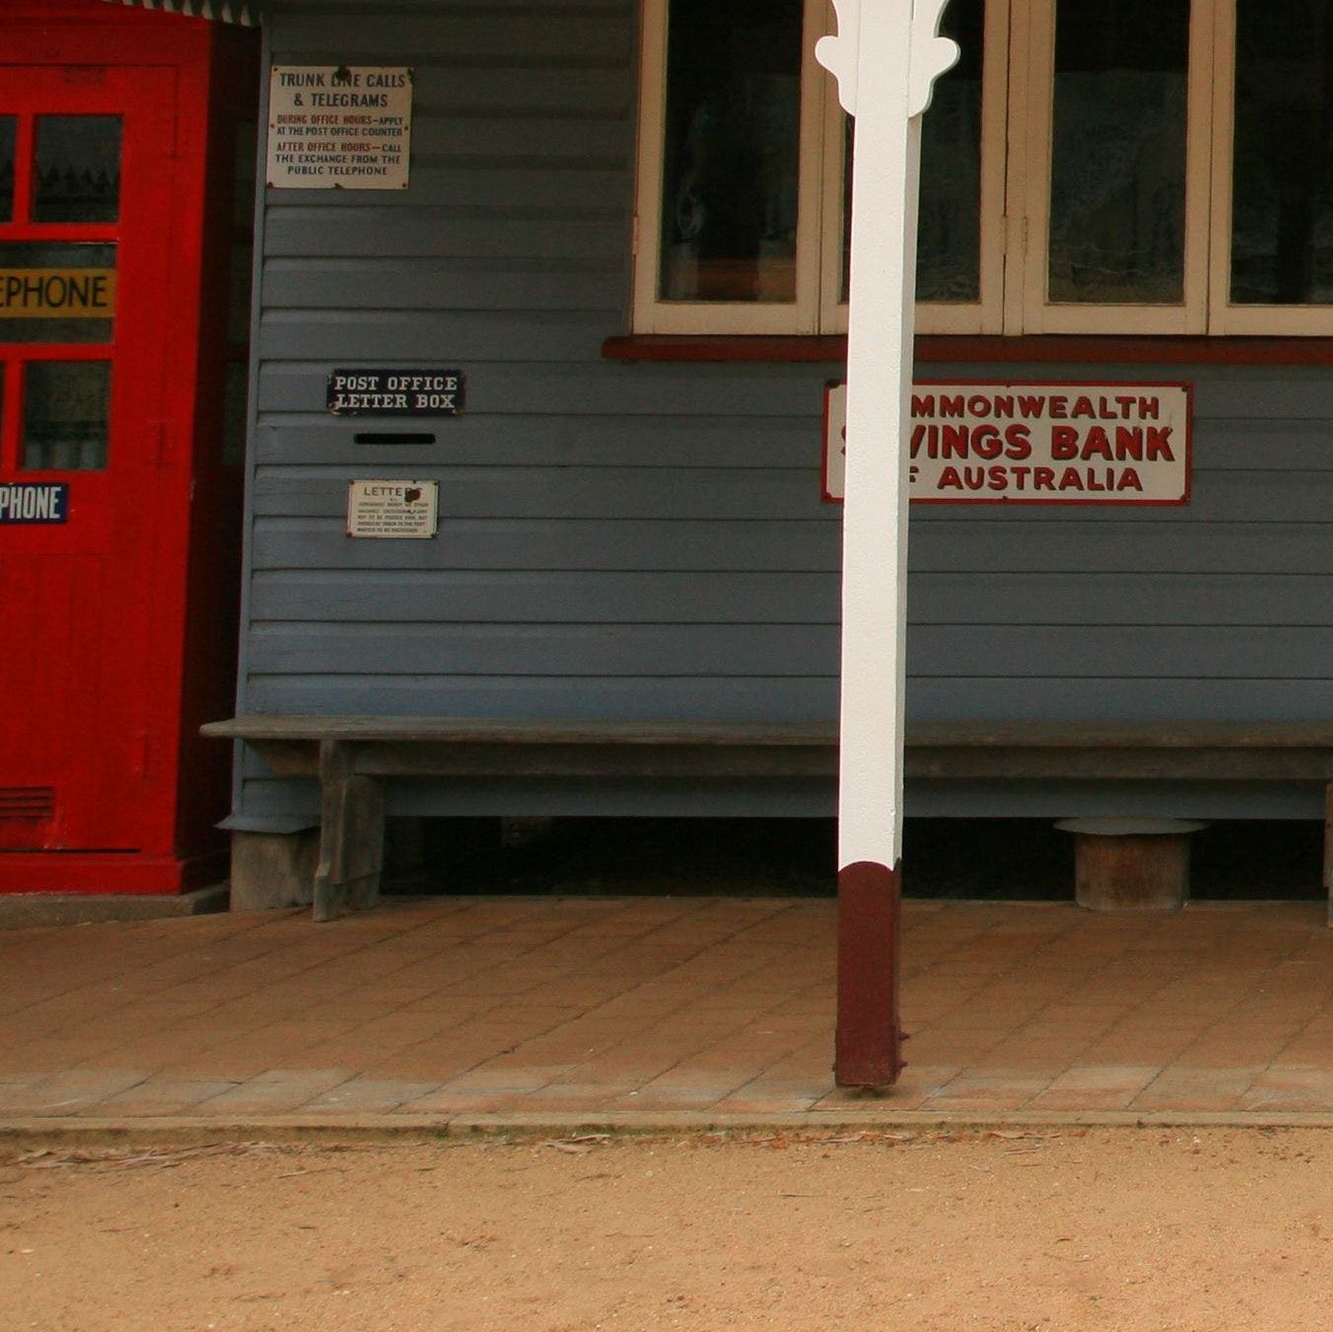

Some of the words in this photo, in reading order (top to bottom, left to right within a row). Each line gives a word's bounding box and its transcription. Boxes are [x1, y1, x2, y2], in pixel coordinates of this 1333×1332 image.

[280, 73, 325, 87] TRUNK
[366, 74, 406, 88] CALLS
[294, 93, 304, 107] &
[311, 93, 388, 107] TELEGRAMS
[277, 114, 308, 124] DURING
[311, 114, 339, 124] OFFICE
[276, 127, 287, 136] AT
[289, 127, 304, 136] THE
[306, 127, 327, 136] POST
[330, 127, 359, 136] OFFICE
[361, 128, 403, 137] COUNTER
[277, 142, 305, 152] AFTER
[307, 142, 337, 152] OFFICE
[275, 154, 294, 163] THE
[298, 155, 347, 163] EXCHANGE
[351, 155, 378, 164] FROM
[382, 155, 401, 164] THE
[287, 166, 325, 175] PUBLIC
[328, 166, 387, 176] TELEPHONE
[334, 376, 379, 390] POST
[387, 376, 457, 391] OFFICE
[337, 394, 408, 408] LETTER
[416, 394, 455, 408] BOX
[911, 394, 1160, 420] MMONWEALTH
[840, 423, 1033, 461] VINGS
[1050, 424, 1176, 462] BANK
[937, 466, 1144, 492] AUSTRALIA
